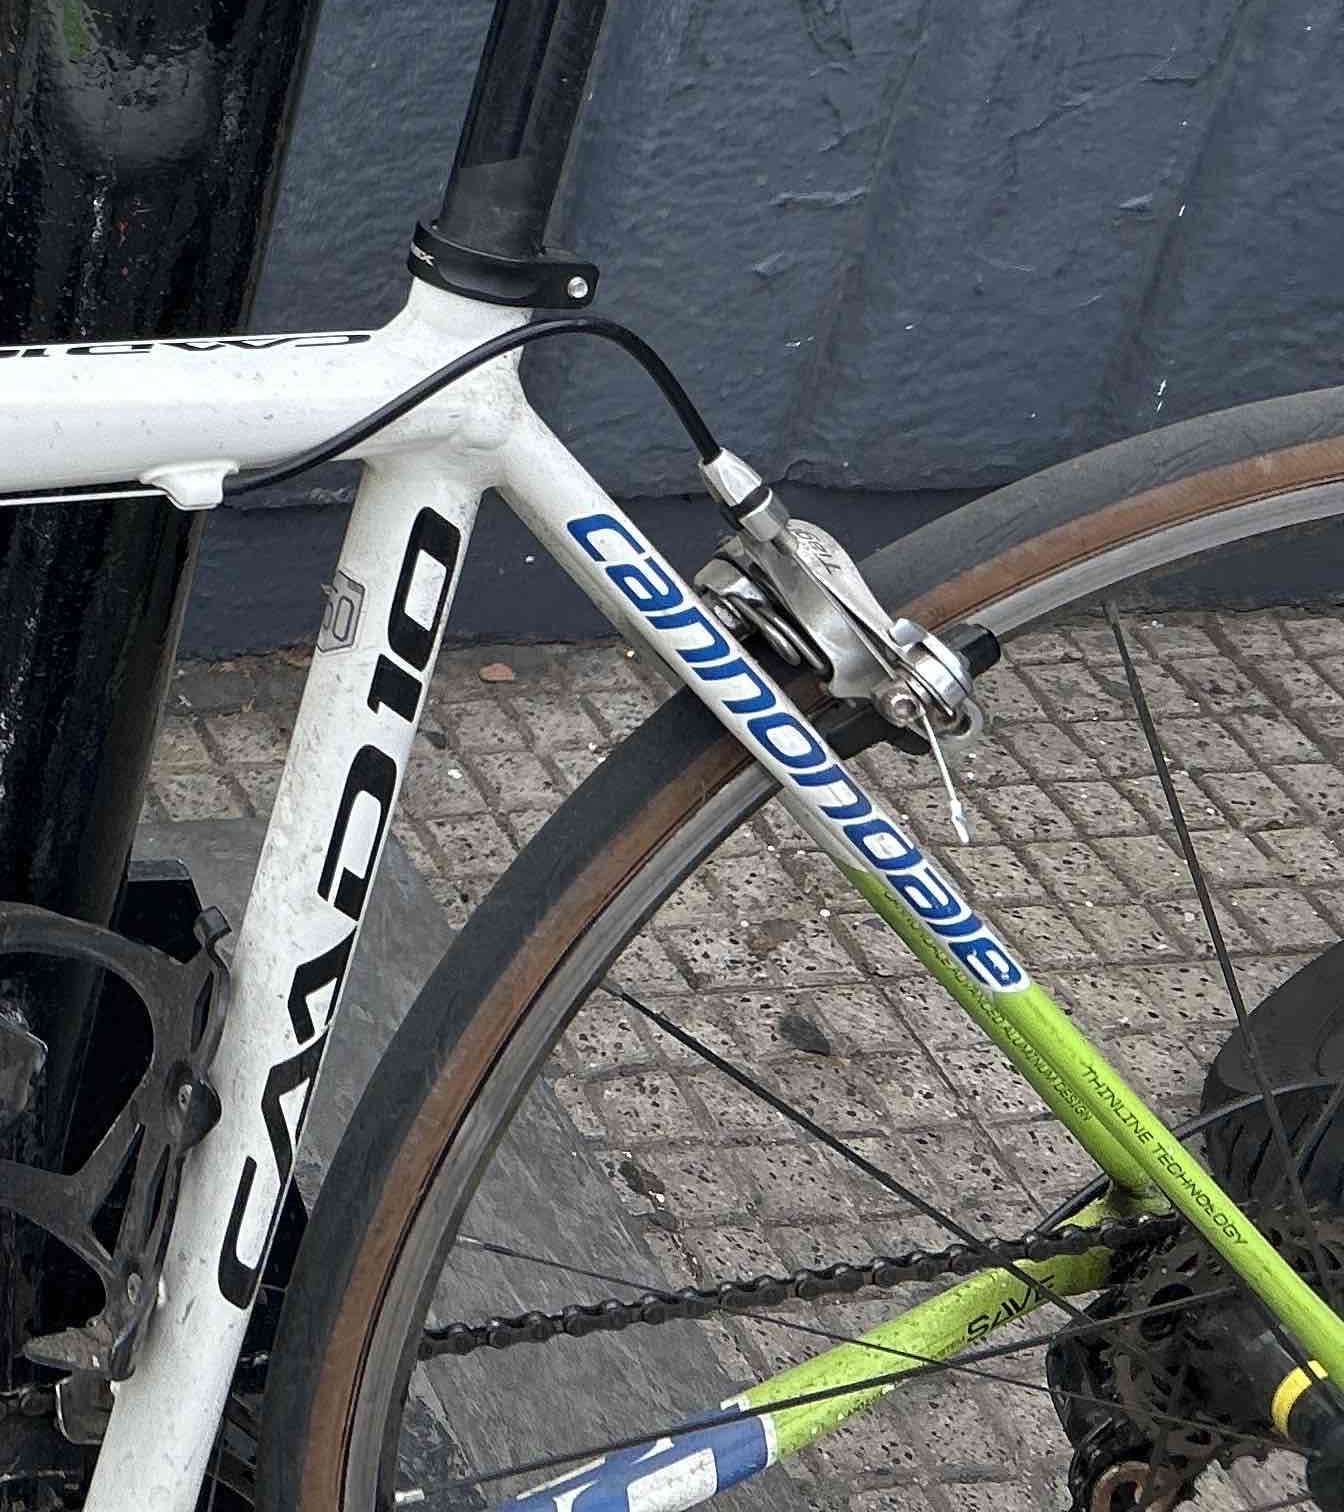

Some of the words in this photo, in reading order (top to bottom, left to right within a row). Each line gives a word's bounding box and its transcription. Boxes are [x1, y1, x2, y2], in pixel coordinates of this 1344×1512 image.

[218, 507, 461, 1309] CAAD10
[1081, 1062, 1154, 1144] THINLINE
[1151, 1142, 1248, 1245] TECHNOLOGY
